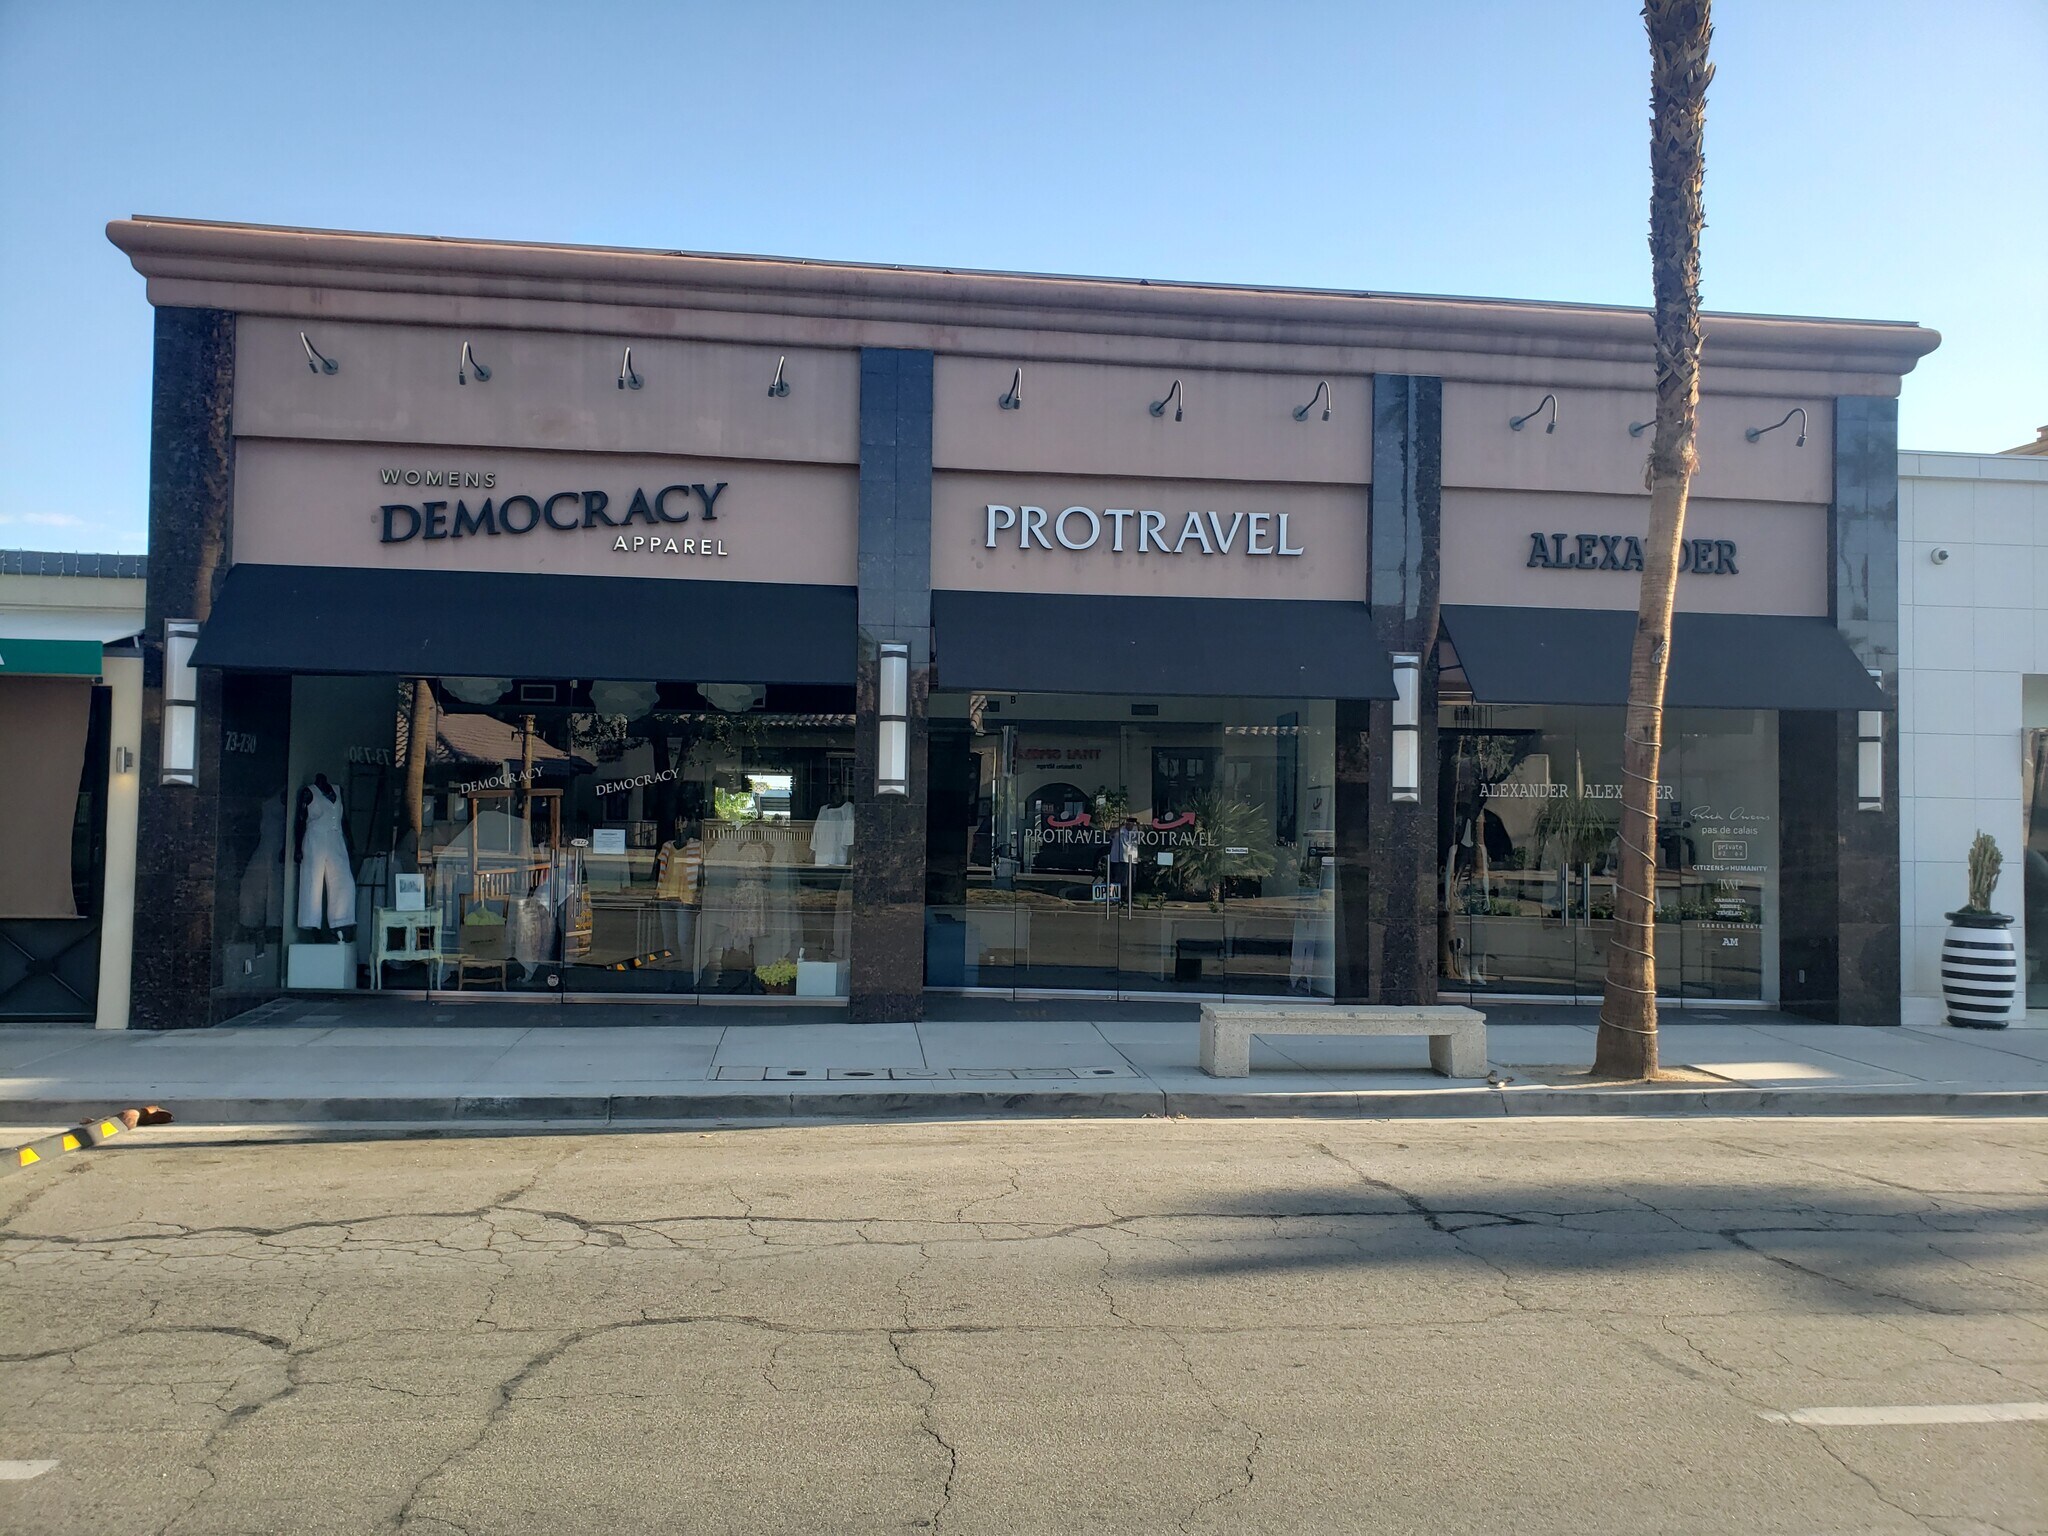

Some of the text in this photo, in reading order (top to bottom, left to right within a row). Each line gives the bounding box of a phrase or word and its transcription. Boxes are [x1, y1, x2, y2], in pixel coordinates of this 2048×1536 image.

[380, 468, 497, 488] WOMENS
[379, 482, 729, 544] DEMOCRACY
[985, 504, 1304, 555] PROTRAVEL
[613, 535, 728, 556] APPAREL
[1526, 532, 1739, 575] ALEXAER
[1010, 695, 1017, 704] B
[225, 731, 257, 754] 73-730
[460, 766, 544, 794] DEMOCRACY
[596, 768, 680, 796] DEMOCRACY
[1479, 783, 1569, 798] ALEXANDER
[1583, 784, 1674, 800] ALEXER
[1024, 828, 1111, 844] PROTRAVEL
[1128, 831, 1215, 847] PROTRAVEL
[1701, 826, 1758, 835] pas de calais
[1721, 937, 1739, 946] AM
